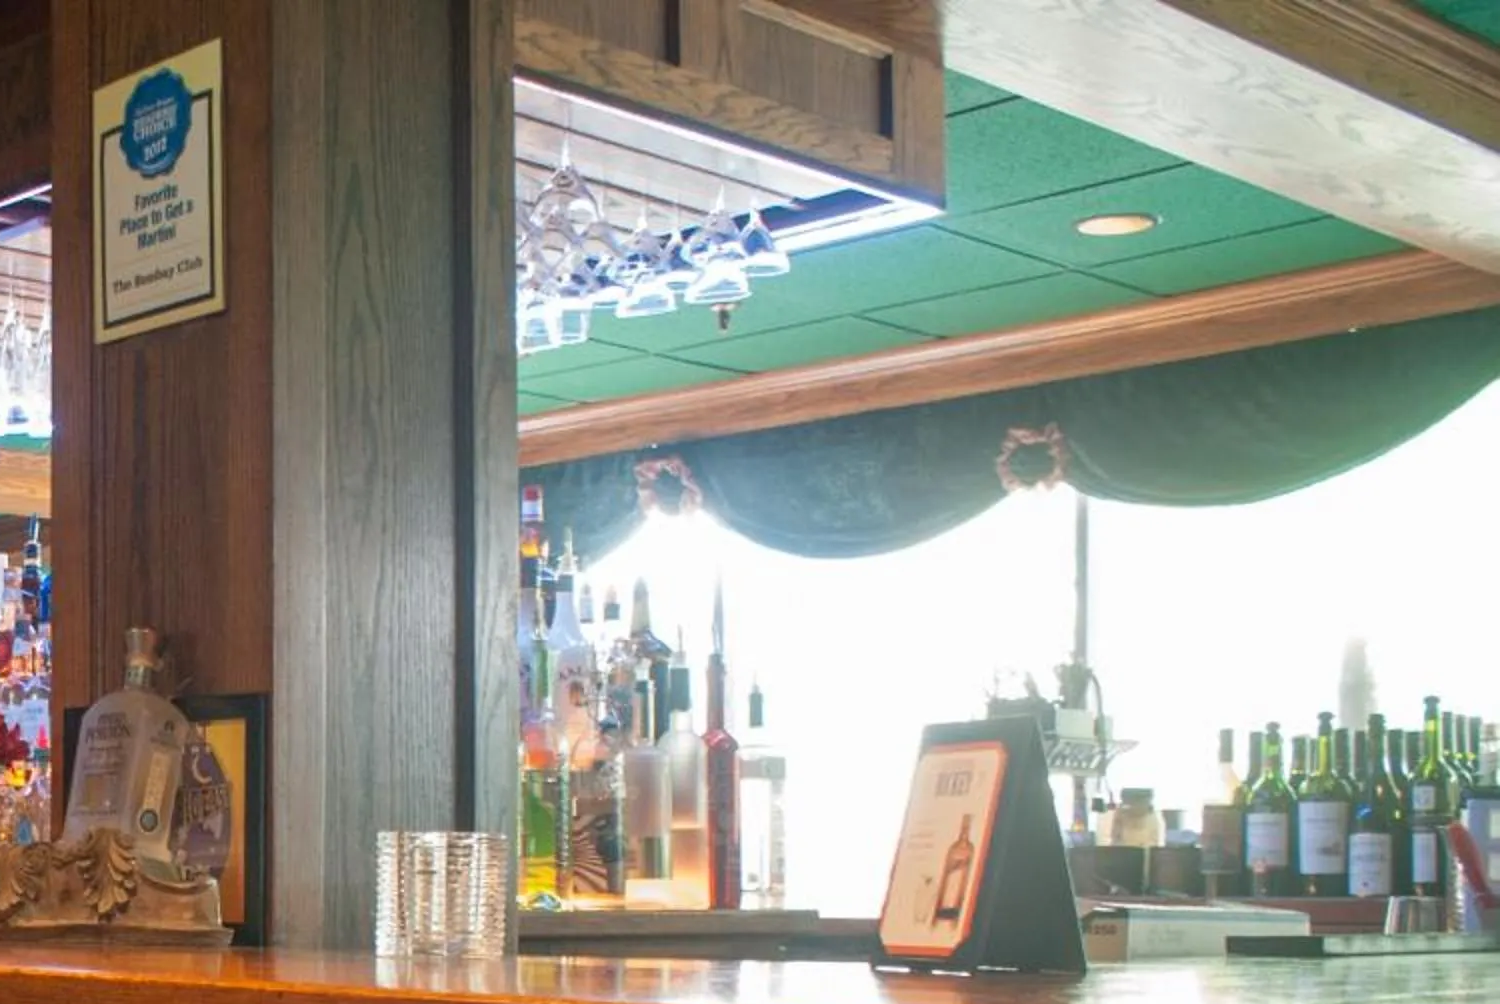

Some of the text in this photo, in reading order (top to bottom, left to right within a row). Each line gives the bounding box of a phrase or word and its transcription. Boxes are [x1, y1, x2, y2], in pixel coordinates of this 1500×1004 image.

[134, 184, 178, 210] Favorite
[119, 214, 148, 235] Place
[151, 209, 162, 224] to
[165, 201, 185, 219] Get
[137, 225, 176, 249] Martini
[113, 256, 203, 294] The Bombay Club
